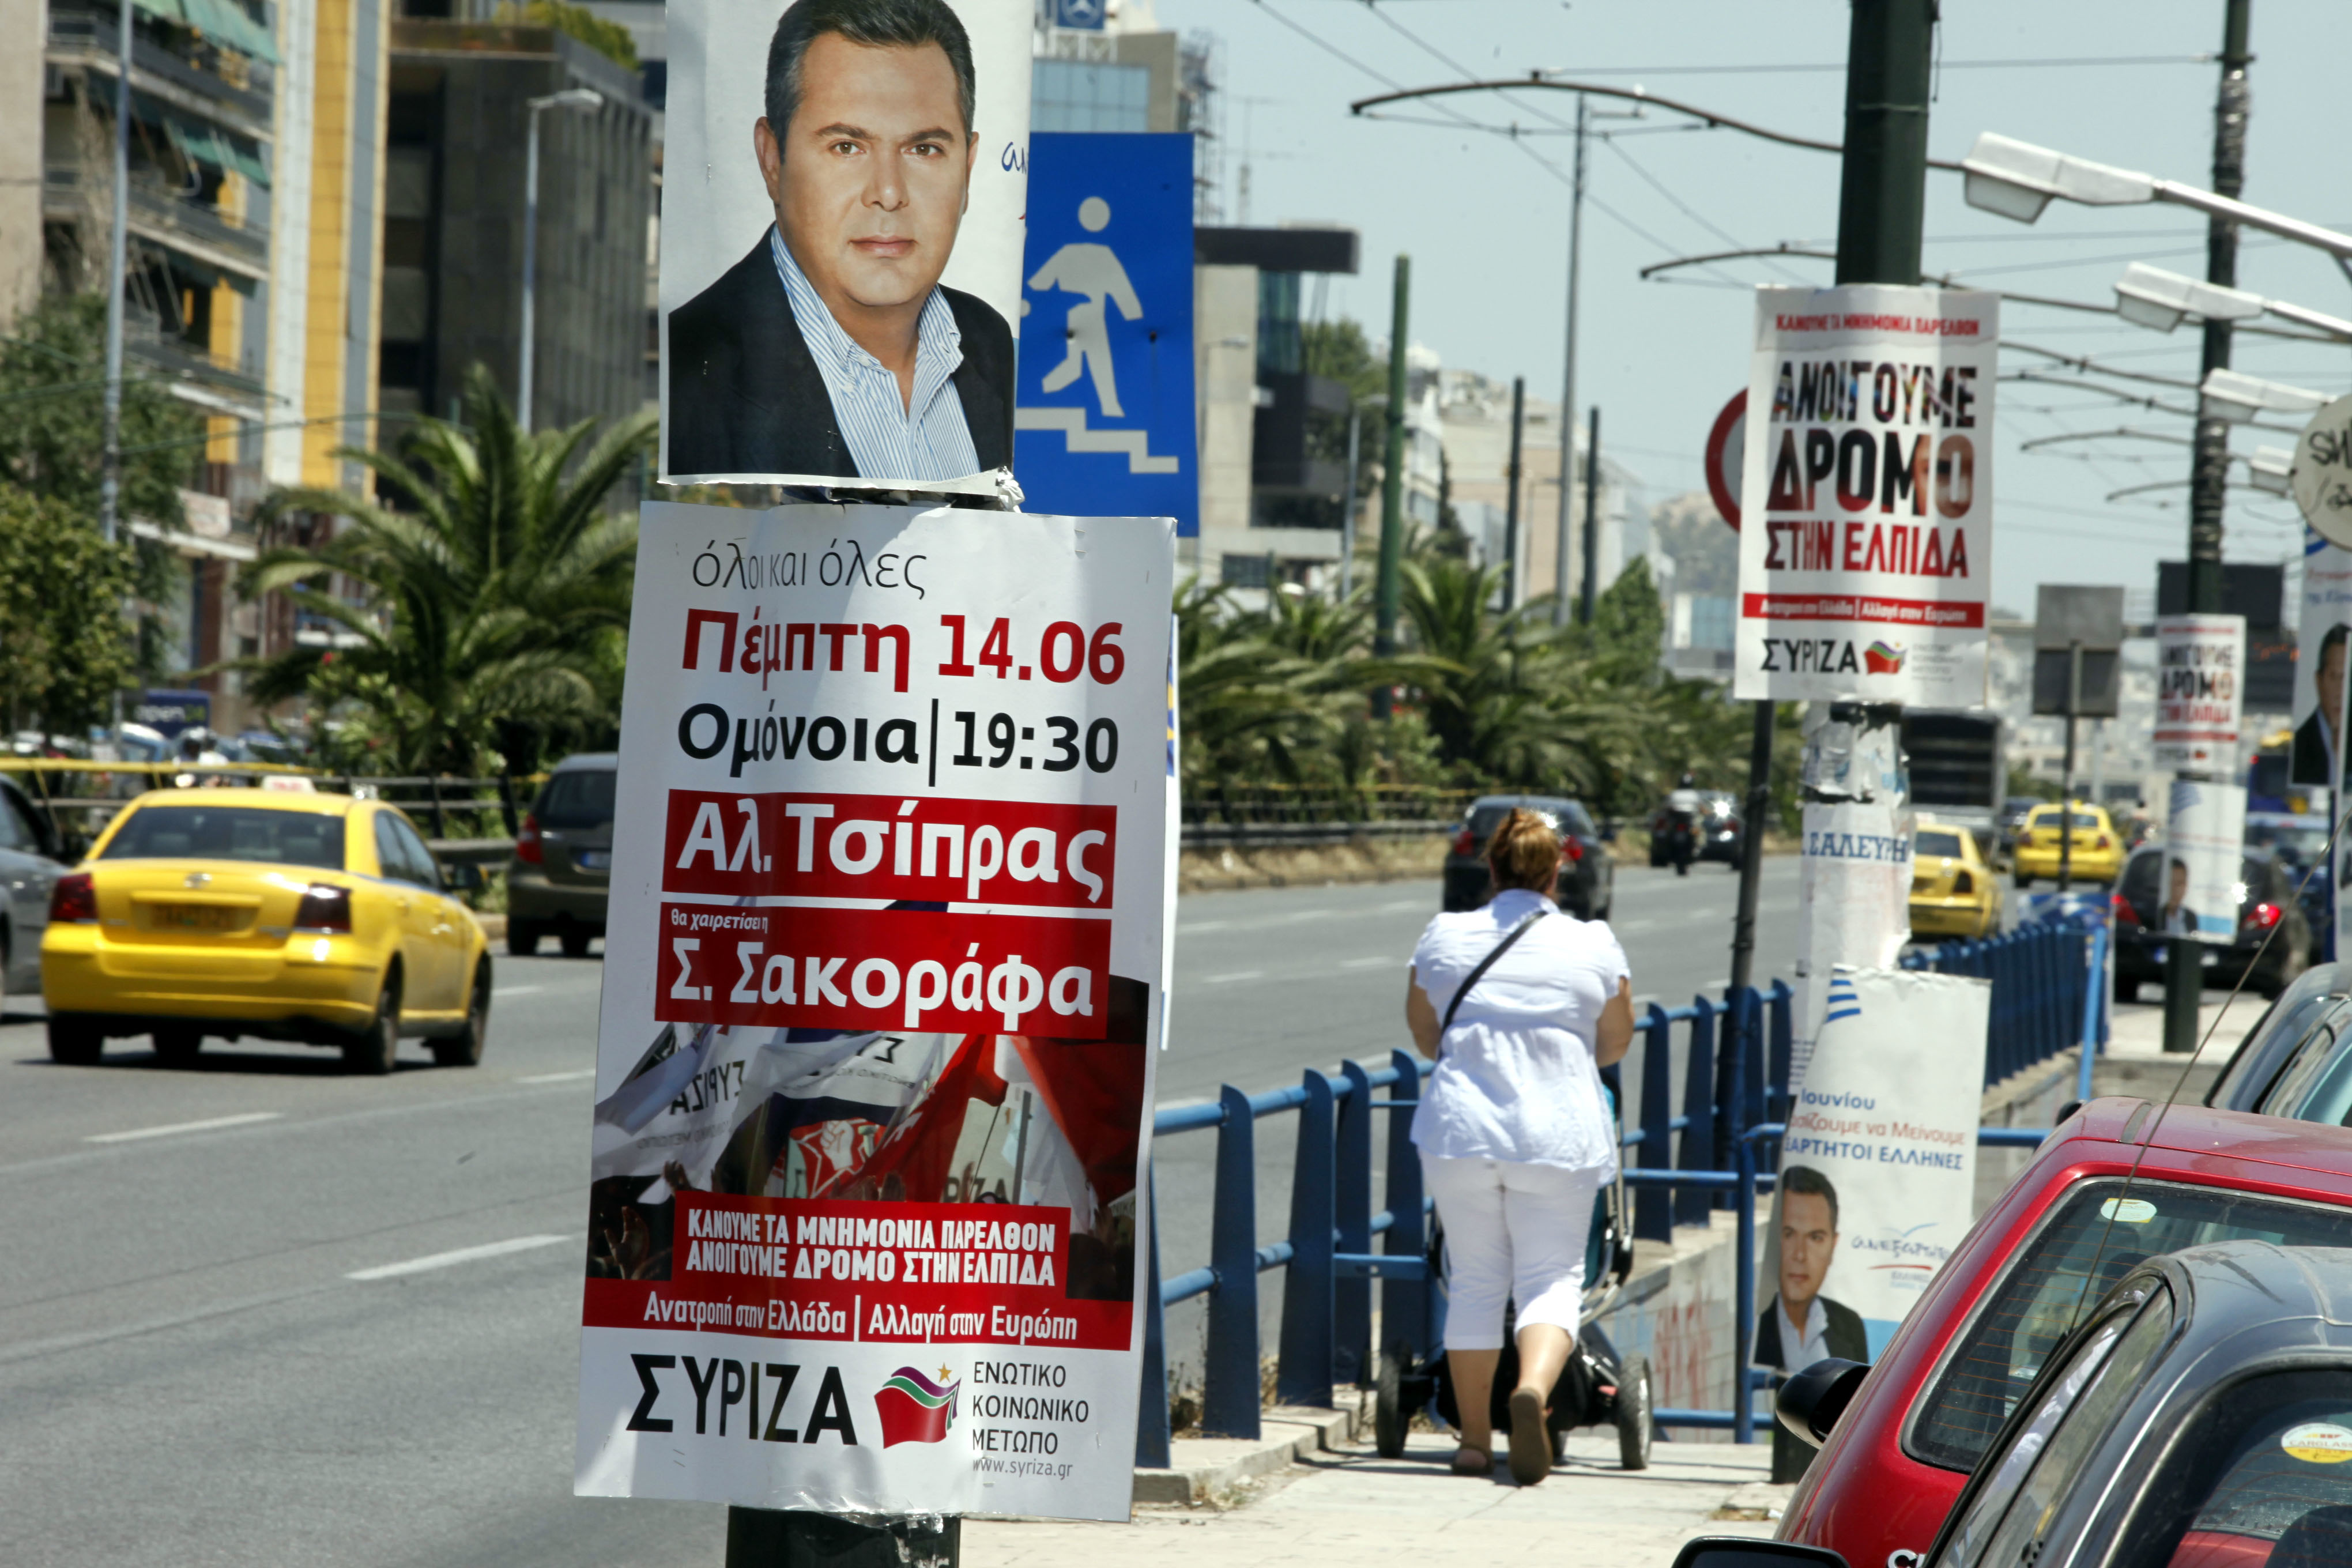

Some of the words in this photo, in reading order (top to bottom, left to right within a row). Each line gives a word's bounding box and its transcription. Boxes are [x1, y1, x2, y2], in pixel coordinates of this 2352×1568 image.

[1769, 361, 1978, 428] ΑΝΟΙΓΟΥΜΕ
[1765, 427, 1974, 519] ΔΡΟΜΟ
[693, 540, 764, 589] όλοι
[769, 552, 806, 587] και
[820, 538, 927, 600] όλες
[1765, 520, 1834, 571] ΣΤΗΝ
[1843, 521, 1969, 578] ΕΛΠΙΔΑ
[683, 606, 910, 692] Πέμπτη
[938, 615, 1125, 685] 14.06
[1760, 639, 1860, 674] ΣΥΡΙΖΑ
[678, 699, 919, 778] Ομόνοια
[952, 710, 1119, 773] 19:30
[677, 798, 771, 873] Αλ.
[786, 800, 1107, 903] Τσίπρας
[672, 908, 688, 926] θα
[690, 912, 760, 932] χαιρετίσει
[762, 917, 768, 934] η
[670, 938, 712, 1001] Σ.
[730, 943, 1094, 1032] Σακοράφα
[1801, 1088, 1875, 1110] Ιουνίου
[1867, 1124, 1886, 1136] να
[1891, 1121, 1966, 1147] Μείνουμε
[1879, 1146, 1963, 1171] ΕΛΛΗΝΕΣ
[688, 1209, 760, 1242] ΚΑΝΟΥΜΕ
[763, 1214, 789, 1244] ΤΑ
[797, 1216, 934, 1249] ΜΝΗΜΟΝΙΑ
[941, 1220, 1054, 1253] ΠΑΡΕΛΘΟΝ
[687, 1242, 786, 1277] ΑΝΟΙΓΟΥΜΕ
[794, 1247, 895, 1282] ΔΡΟΜΟ
[903, 1251, 959, 1283] ΣΤΗΝ
[964, 1252, 1055, 1287] ΕΛΠΙΔΑ
[644, 1291, 733, 1332] Ανατροπή
[736, 1305, 764, 1330] στην
[768, 1299, 846, 1334] Ελλάδα
[868, 1304, 946, 1343] Αλλαγή
[949, 1311, 983, 1337] στην
[990, 1306, 1077, 1345] Ευρώπη
[974, 1361, 1066, 1388] ΕΝΩΤΙΚΟ
[626, 1354, 858, 1446] ΣΥΡΙΖΑ
[973, 1394, 1089, 1423] ΚΟΙΝΩΝΙΚΟ
[973, 1431, 1058, 1455] ΜΕΤΩΠΟ
[973, 1457, 1073, 1480] www.syriza.gr
